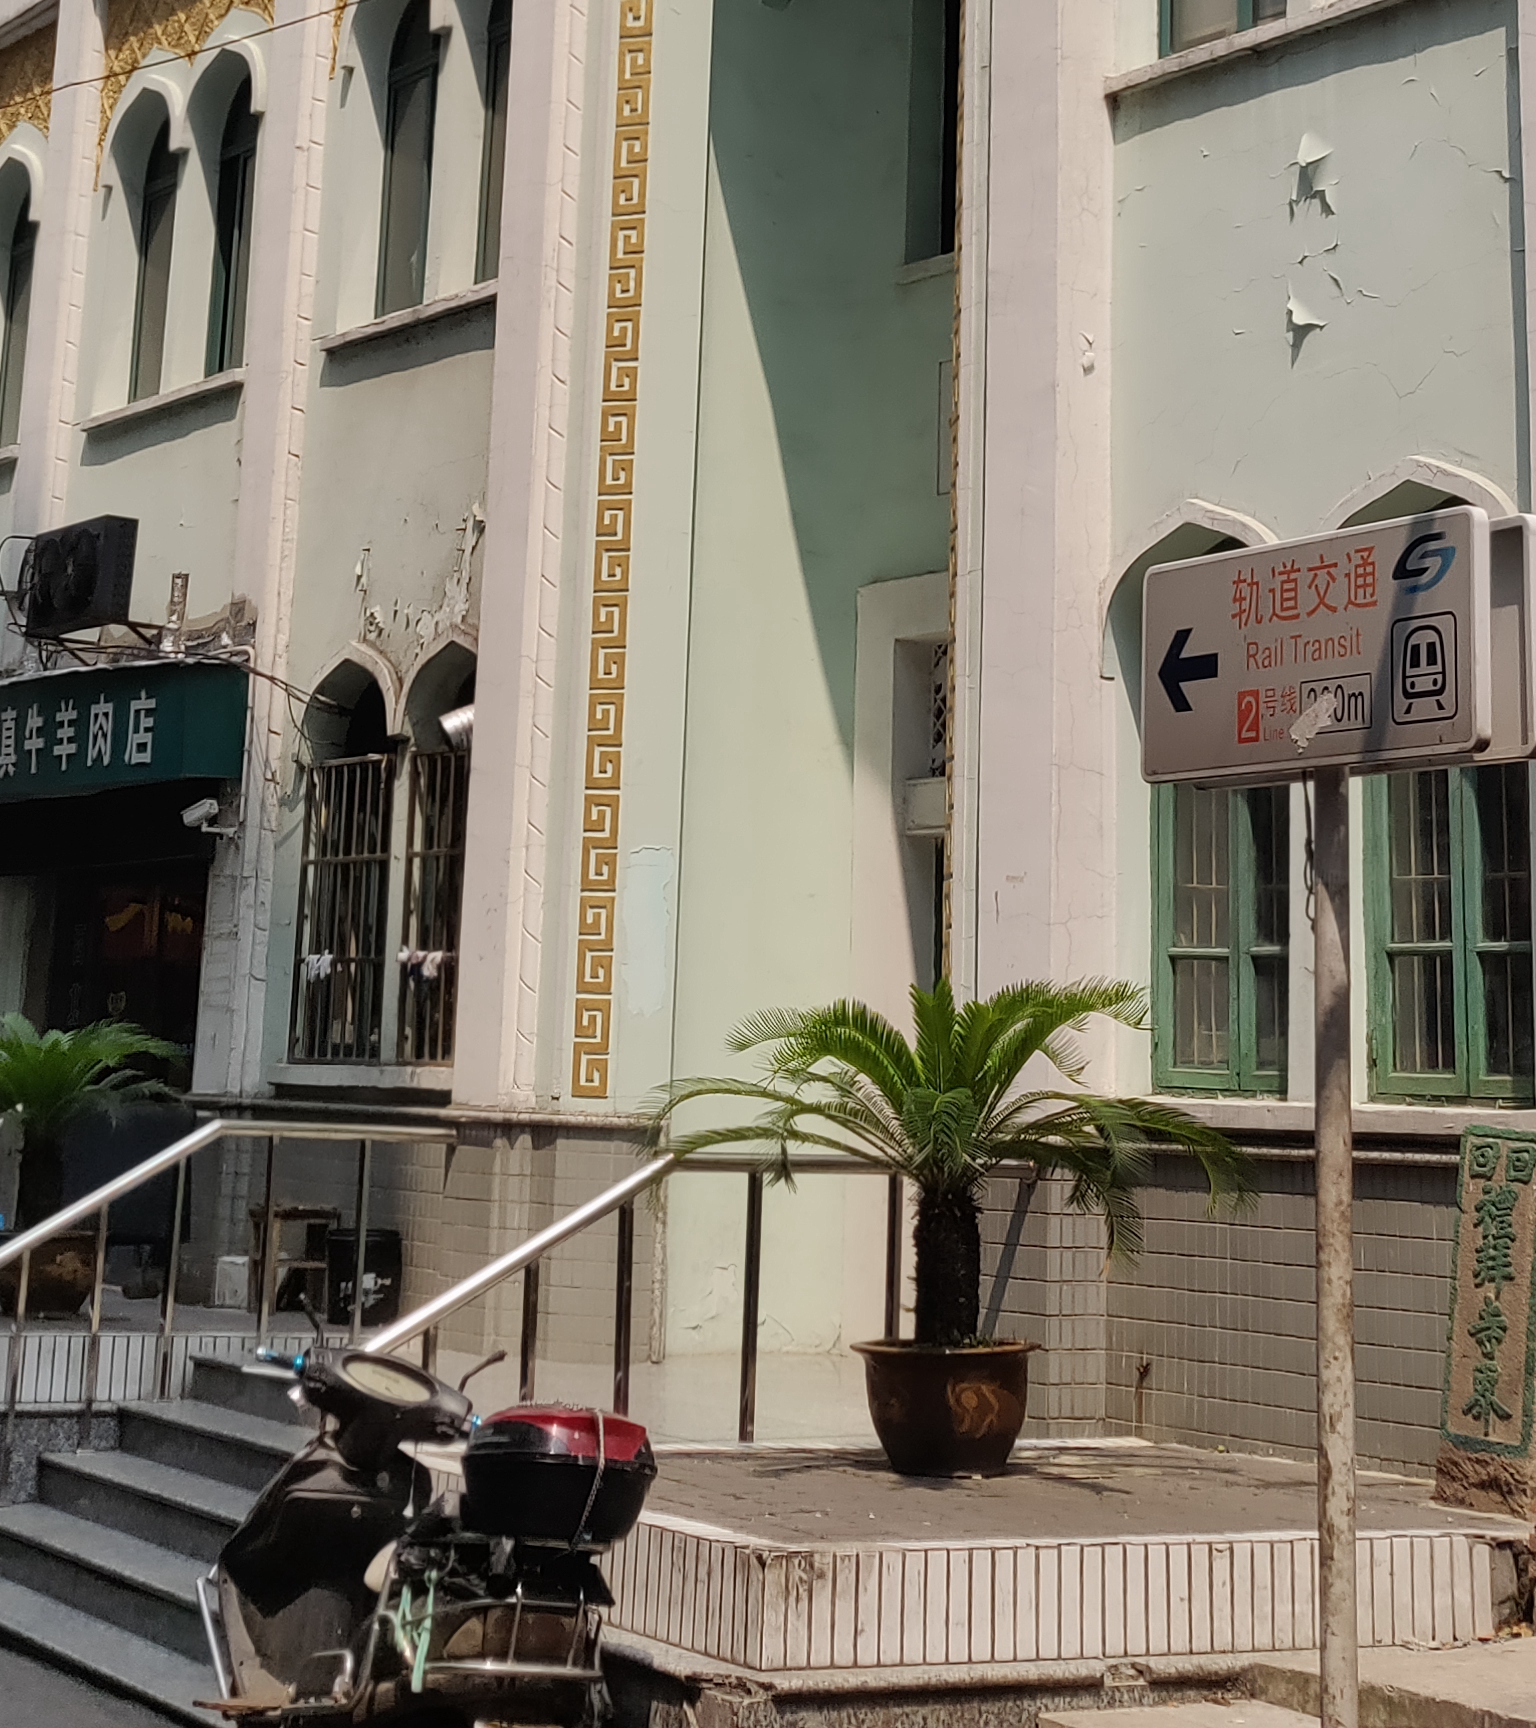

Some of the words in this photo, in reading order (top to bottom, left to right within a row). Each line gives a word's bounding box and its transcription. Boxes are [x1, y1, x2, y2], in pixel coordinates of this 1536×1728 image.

[1230, 545, 1378, 631] 轨道交通
[1246, 637, 1284, 671] Rail
[1290, 627, 1363, 665] Transit
